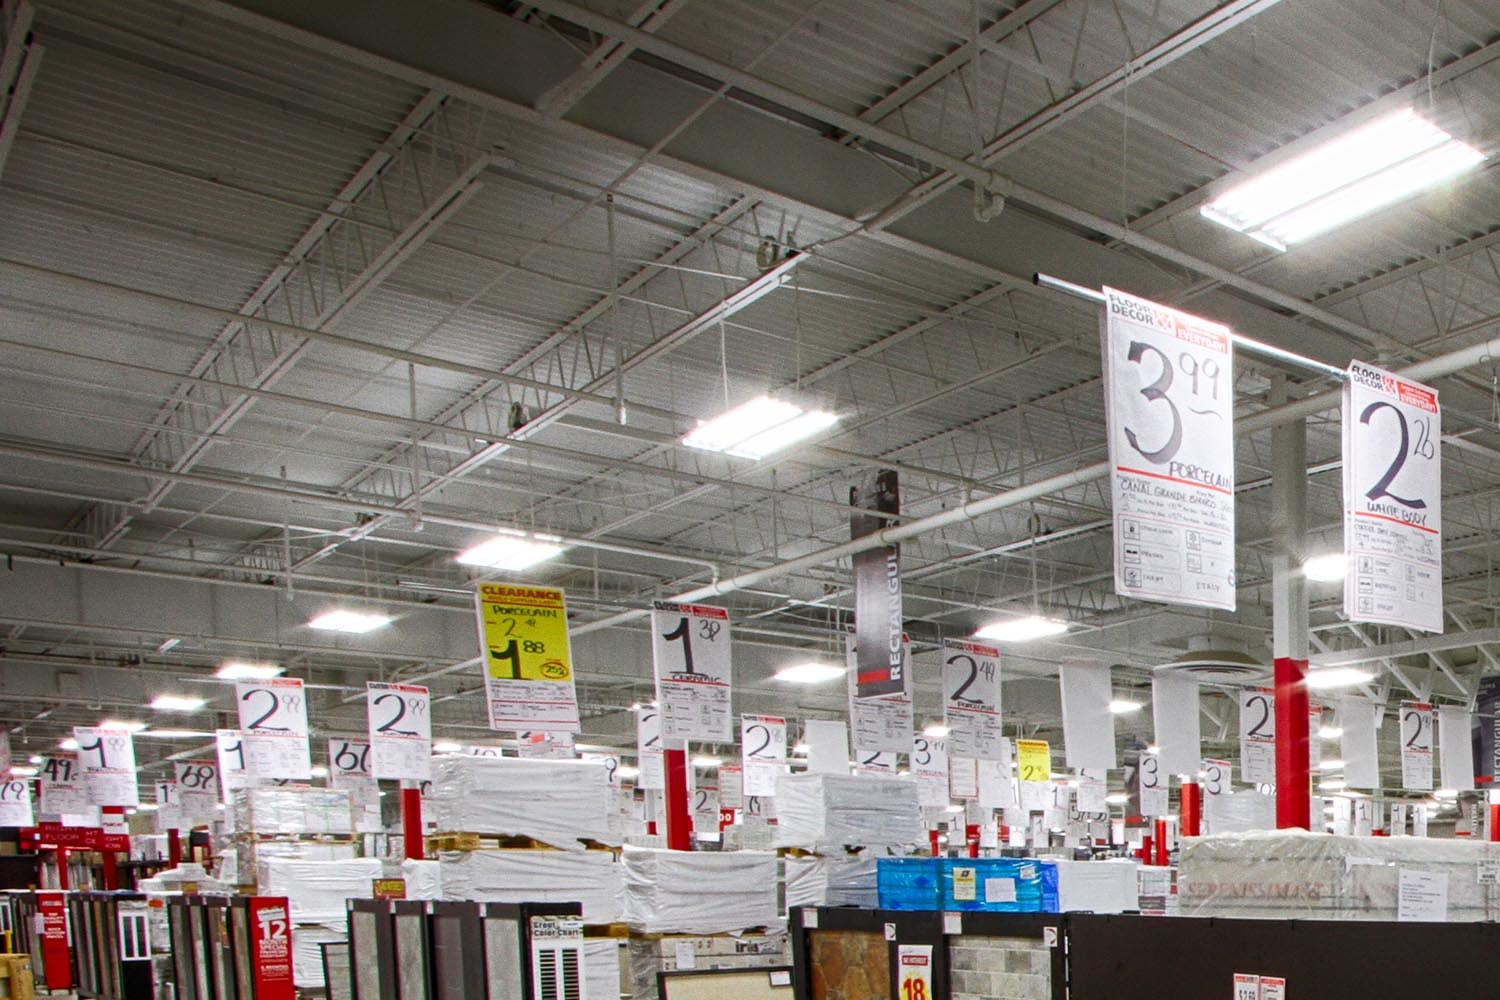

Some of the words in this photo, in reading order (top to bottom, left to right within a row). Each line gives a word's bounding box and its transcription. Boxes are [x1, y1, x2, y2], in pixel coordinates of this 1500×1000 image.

[1109, 293, 1152, 315] FLOOR
[1111, 303, 1154, 326] DECOR
[1351, 364, 1381, 381] FLOOR
[1353, 374, 1385, 392] DECOR
[1124, 340, 1183, 465] 3
[1359, 401, 1427, 509] 2
[1367, 501, 1400, 519] WHITE
[1401, 509, 1427, 526] BODY
[481, 585, 562, 601] CLEARANCE
[886, 519, 901, 681] RECTANGULR
[523, 640, 545, 654] 88
[946, 654, 984, 704] 2
[242, 689, 290, 731] 2
[374, 694, 419, 736] 2
[1245, 695, 1274, 738] 2
[745, 724, 776, 758] 2
[1404, 711, 1429, 749] 2
[258, 920, 288, 940] 12
[533, 929, 556, 937] Color
